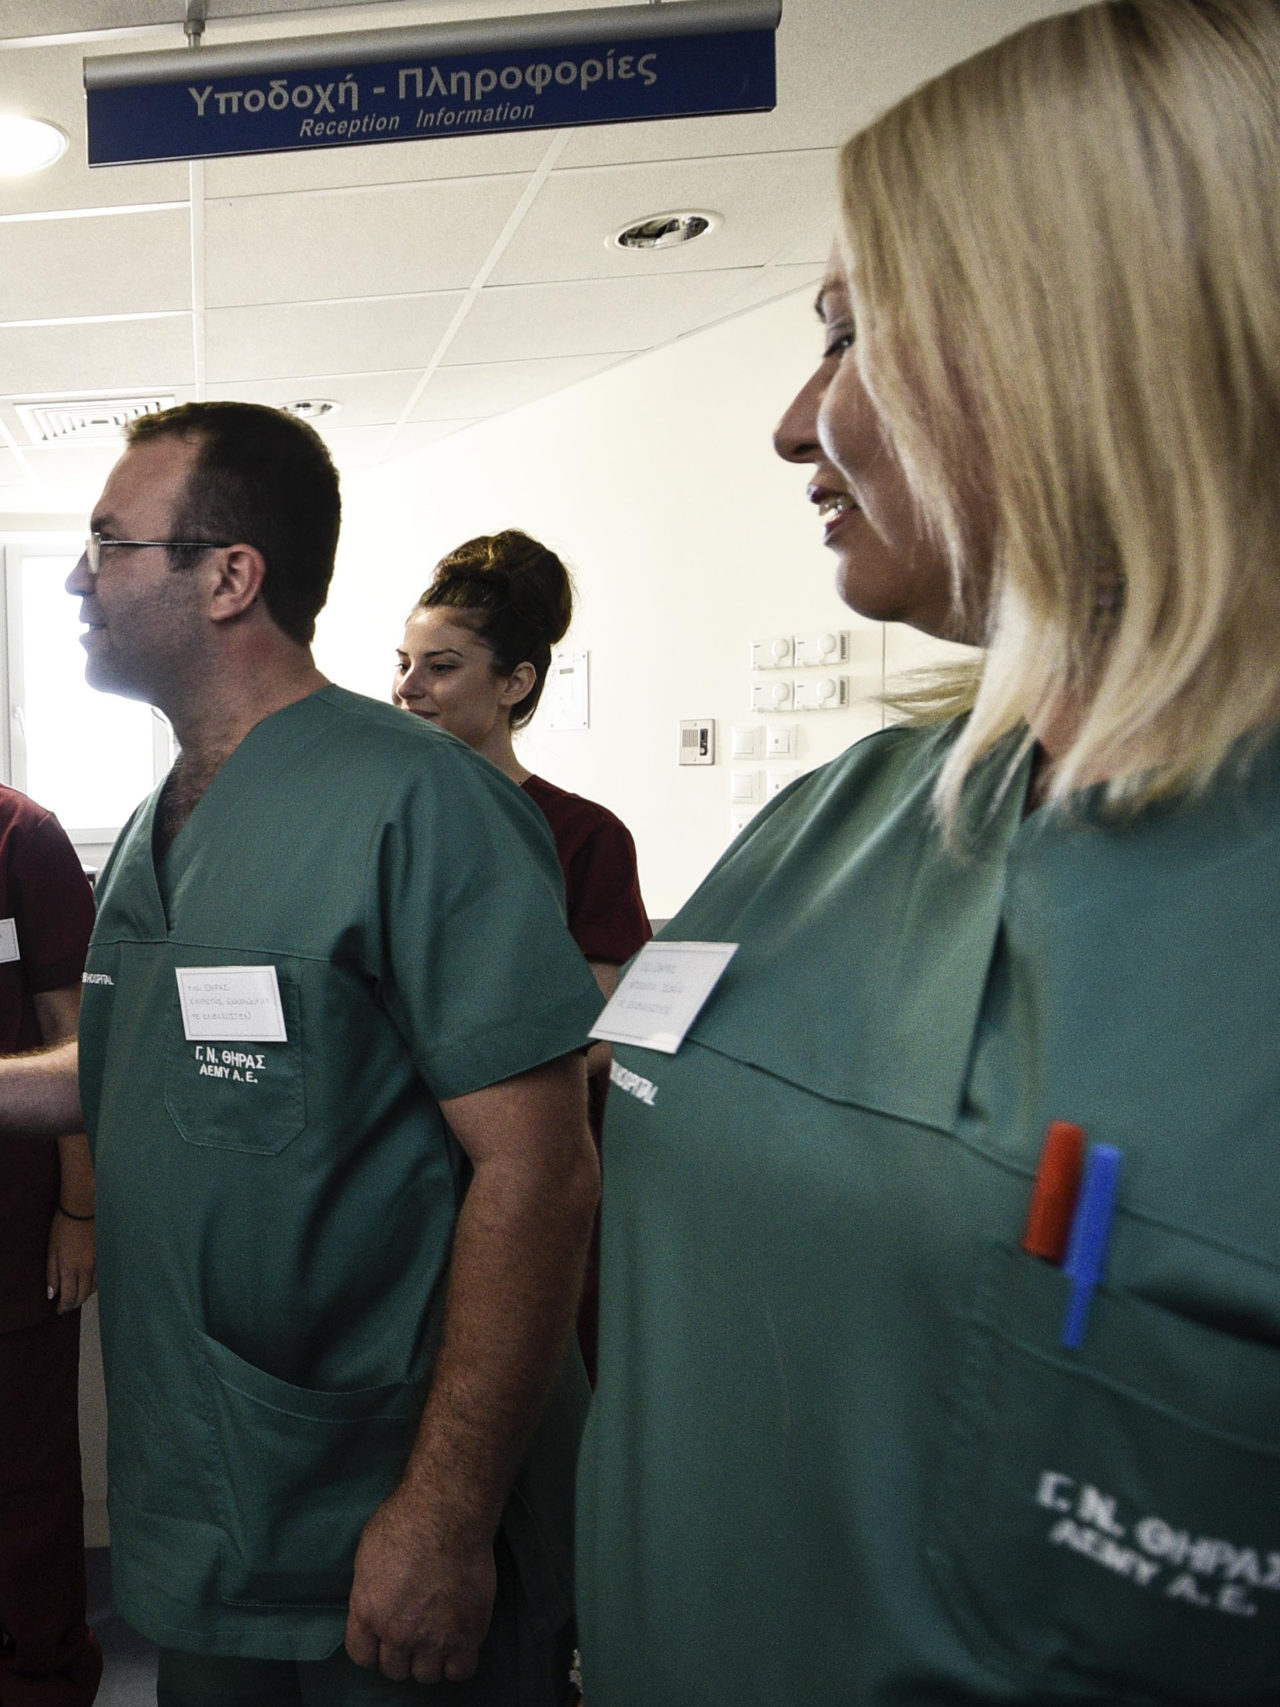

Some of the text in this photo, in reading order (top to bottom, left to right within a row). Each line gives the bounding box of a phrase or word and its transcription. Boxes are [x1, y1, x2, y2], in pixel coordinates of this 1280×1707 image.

[188, 72, 359, 118] Υποδοχή
[398, 48, 659, 103] Πληροφορίες
[299, 100, 535, 139] Reception Information
[199, 1063, 230, 1079] ΑΕΜΥ
[222, 1050, 267, 1070] ΘΗΡΑΣ
